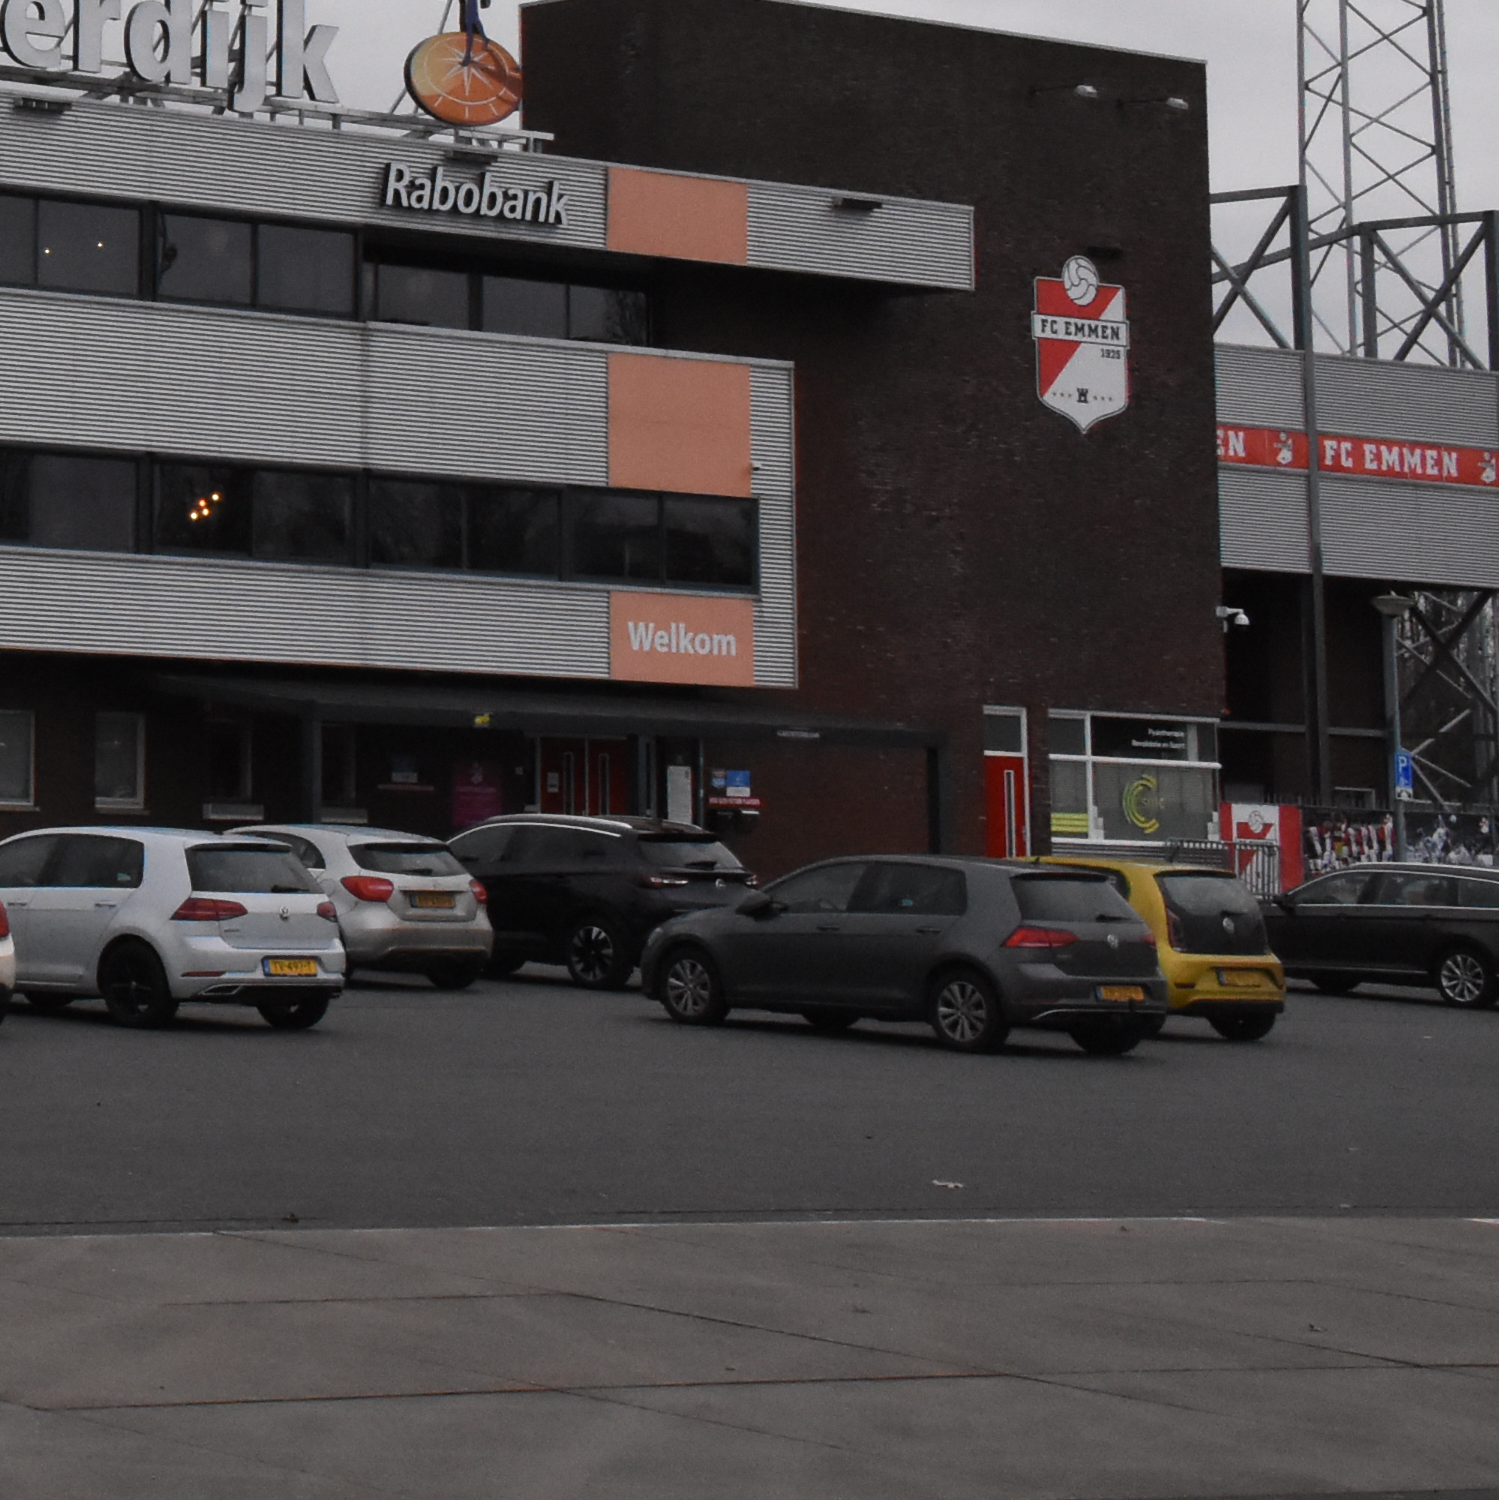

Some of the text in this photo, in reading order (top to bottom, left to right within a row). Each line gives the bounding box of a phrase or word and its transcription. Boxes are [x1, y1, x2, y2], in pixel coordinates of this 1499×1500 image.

[382, 161, 570, 226] Rabobank
[1040, 318, 1120, 341] FC EMMEN
[1323, 440, 1459, 477] FC EMMEN
[627, 621, 737, 656] Welkom
